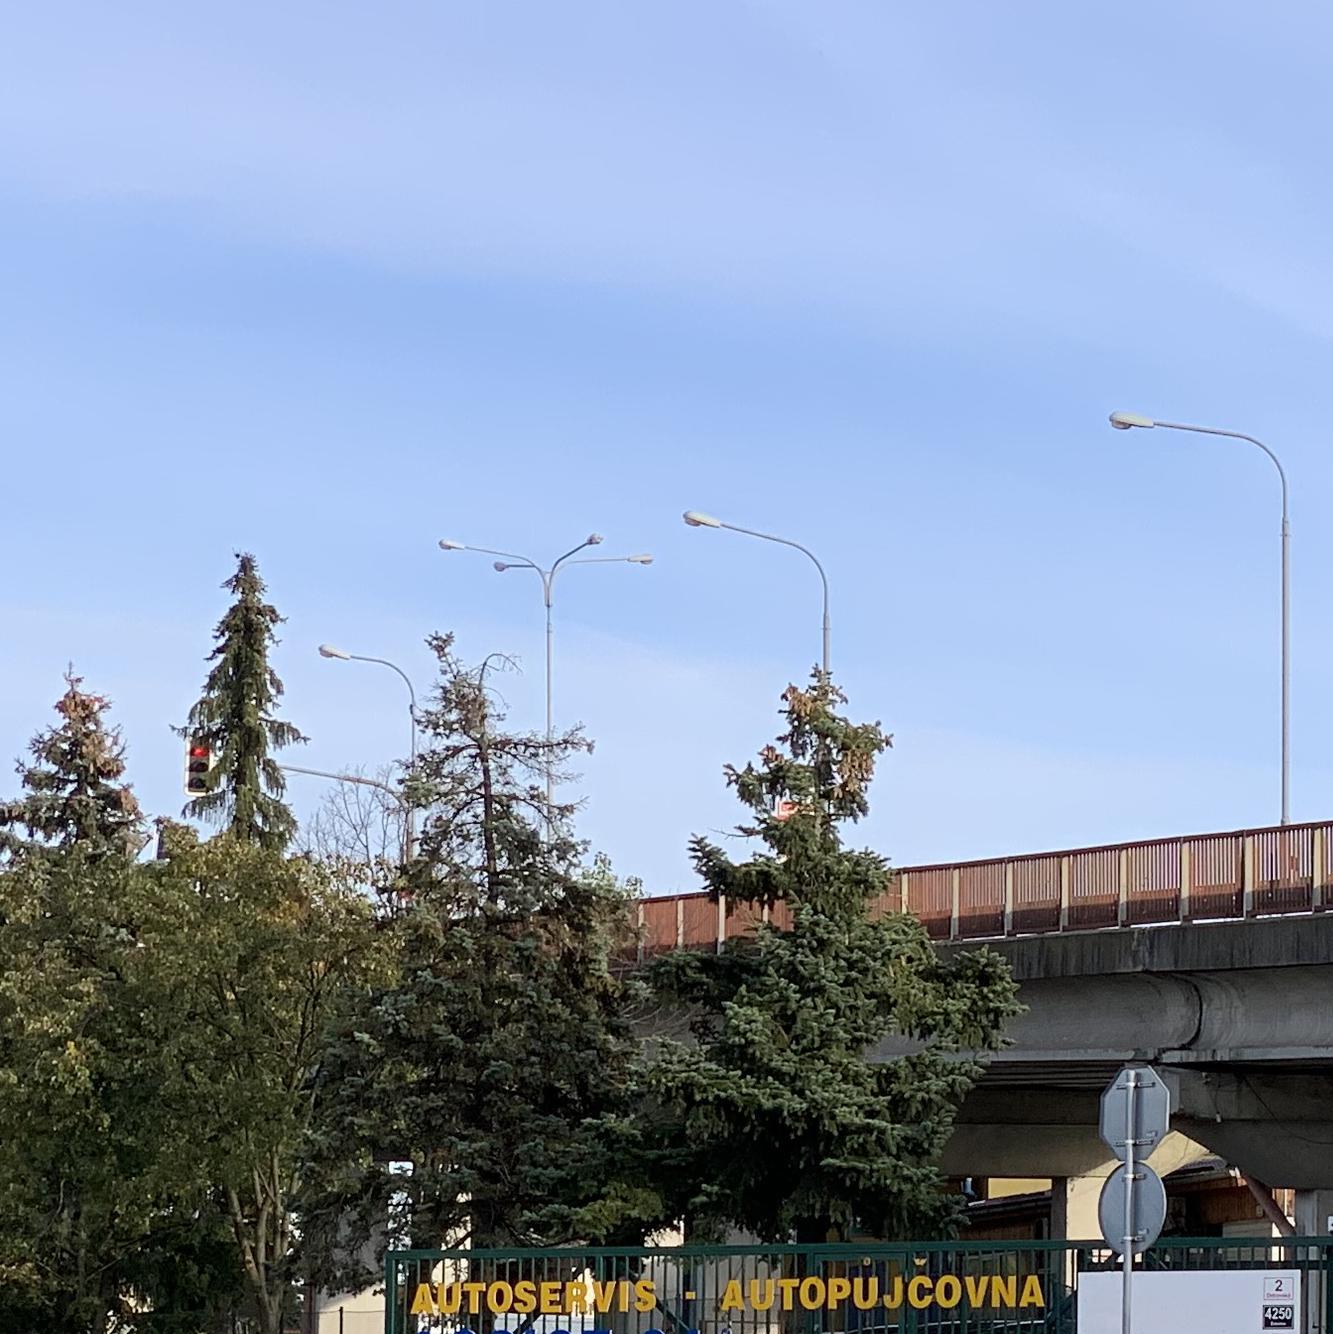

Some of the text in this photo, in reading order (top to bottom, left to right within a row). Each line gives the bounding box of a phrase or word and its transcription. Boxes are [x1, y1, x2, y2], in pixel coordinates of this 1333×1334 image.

[1275, 1279, 1283, 1291] 2
[410, 1280, 657, 1314] AUTOSERVIS
[1264, 1307, 1292, 1320] 4250
